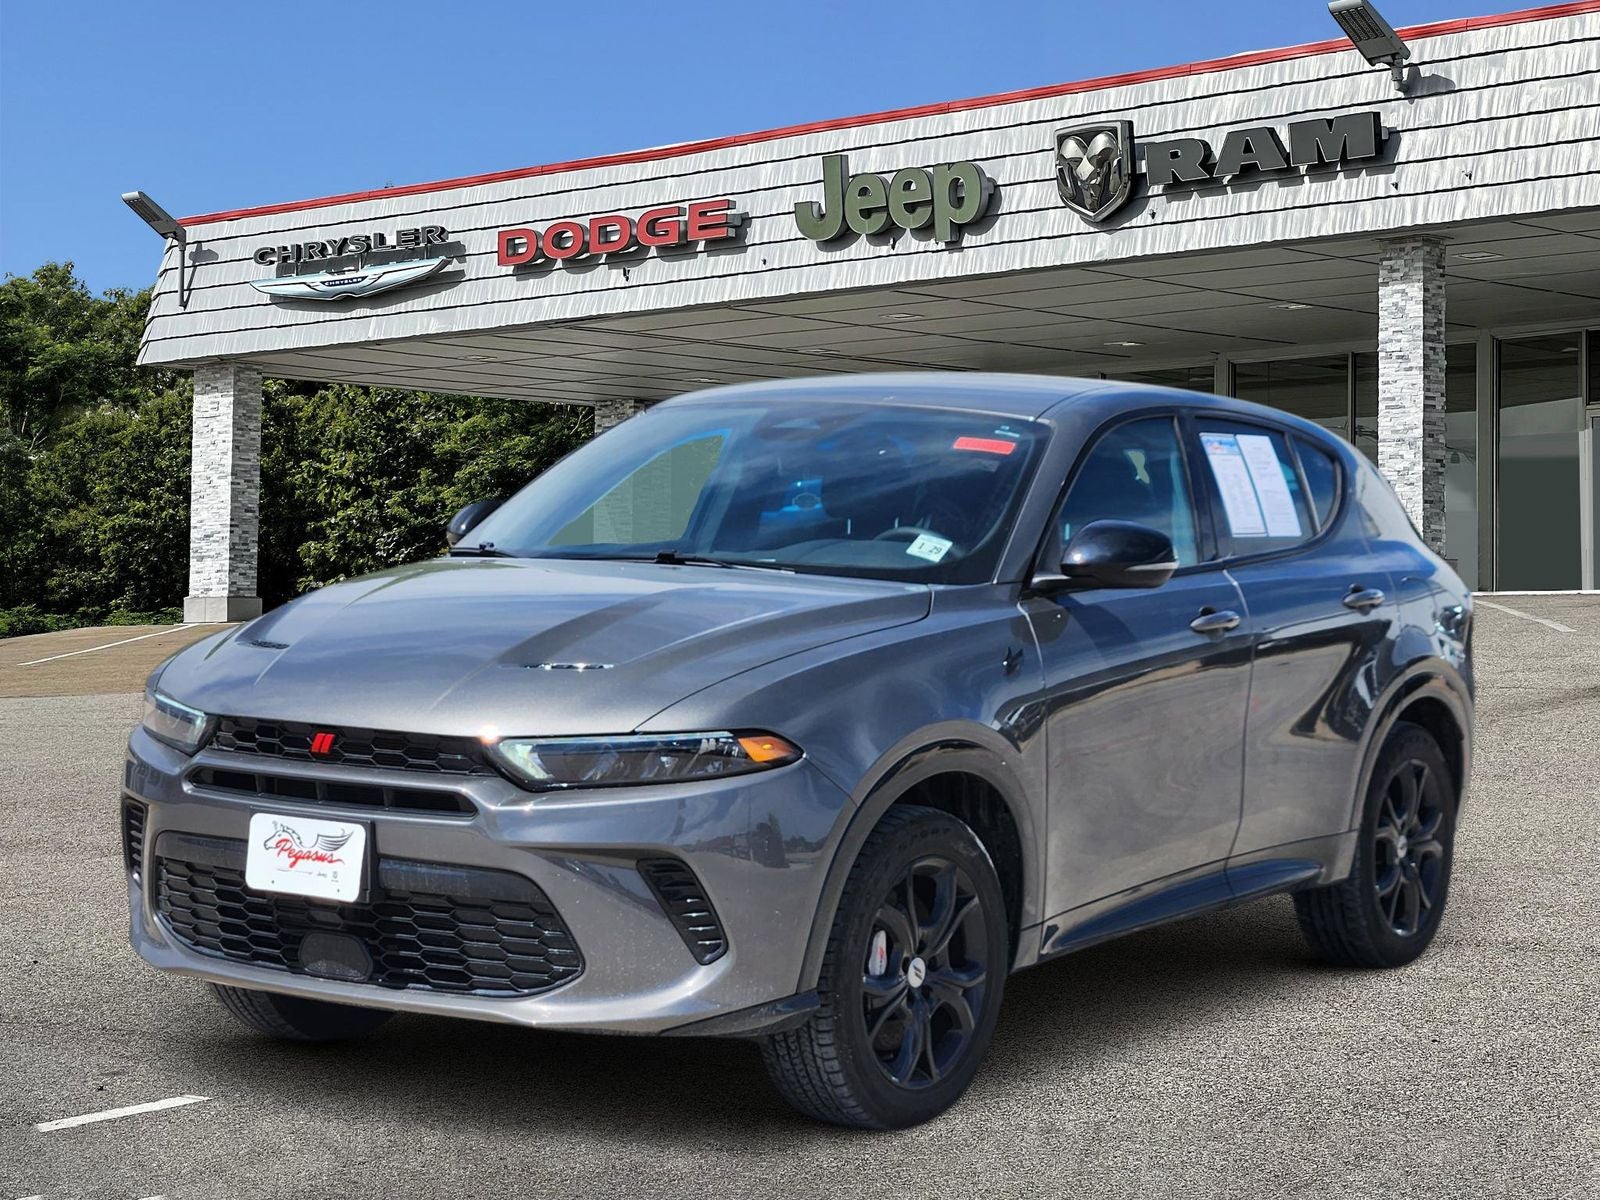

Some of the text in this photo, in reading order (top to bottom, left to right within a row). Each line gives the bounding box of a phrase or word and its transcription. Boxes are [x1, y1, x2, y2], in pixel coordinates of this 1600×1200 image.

[1145, 111, 1381, 187] RAM
[795, 154, 988, 242] Jeep
[253, 225, 449, 266] CHRYSLER
[498, 199, 735, 266] DODGE
[323, 277, 364, 286] CHRYSLER
[275, 838, 345, 868] Pegasus
